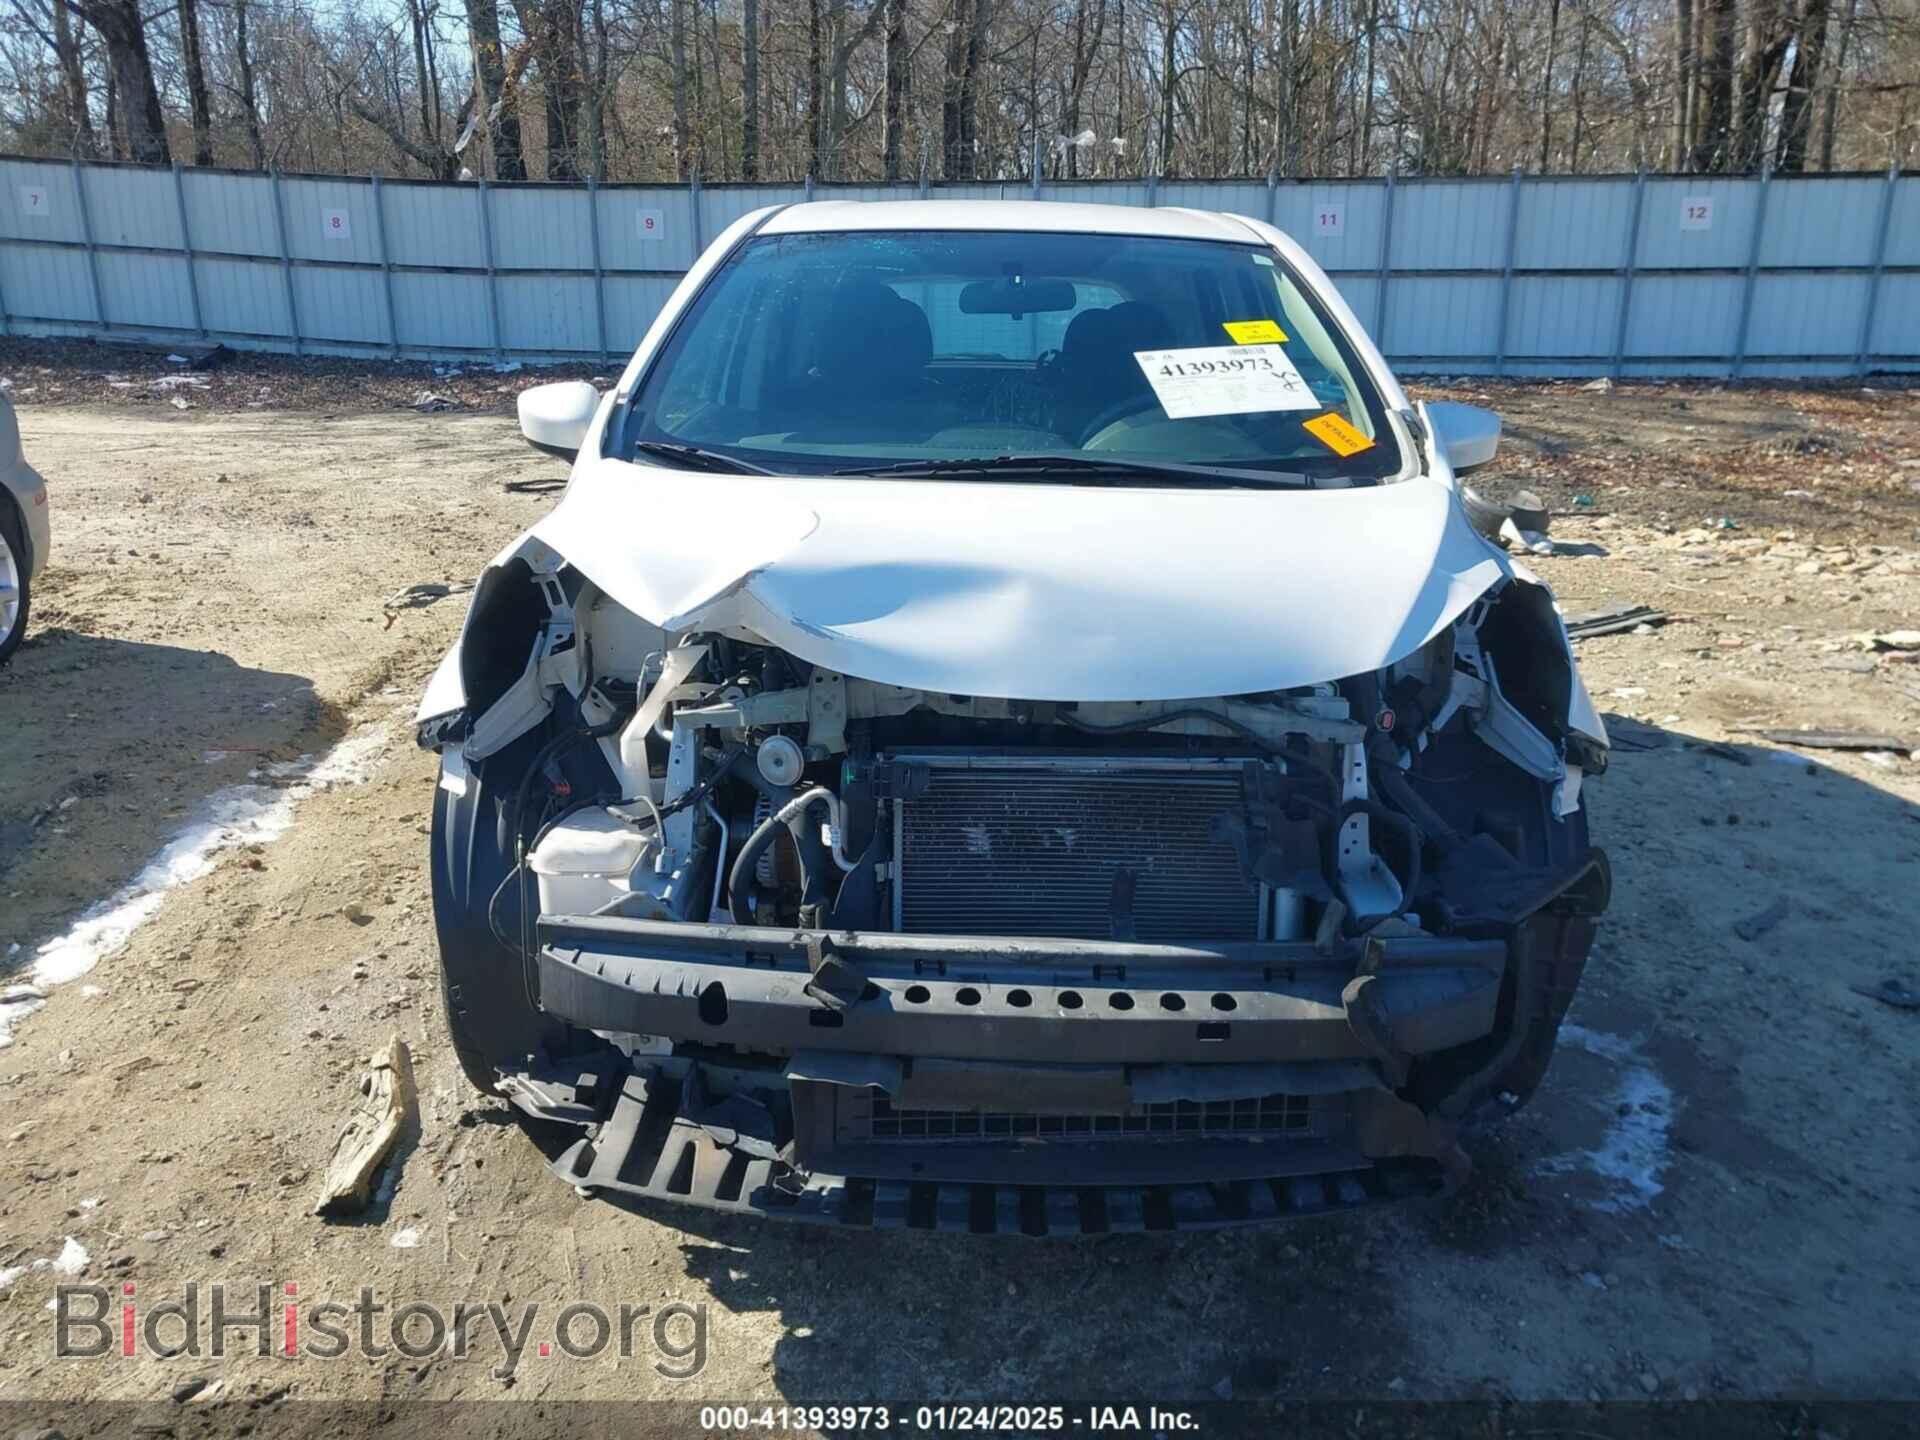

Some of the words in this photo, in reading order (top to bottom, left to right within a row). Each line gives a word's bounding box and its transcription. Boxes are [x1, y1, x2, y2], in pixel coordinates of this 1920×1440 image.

[31, 194, 39, 206] 7
[1688, 206, 1707, 219] 12
[332, 217, 341, 229] 8
[645, 218, 654, 230] 9
[1321, 213, 1337, 226] 11
[1160, 357, 1274, 378] 41393973
